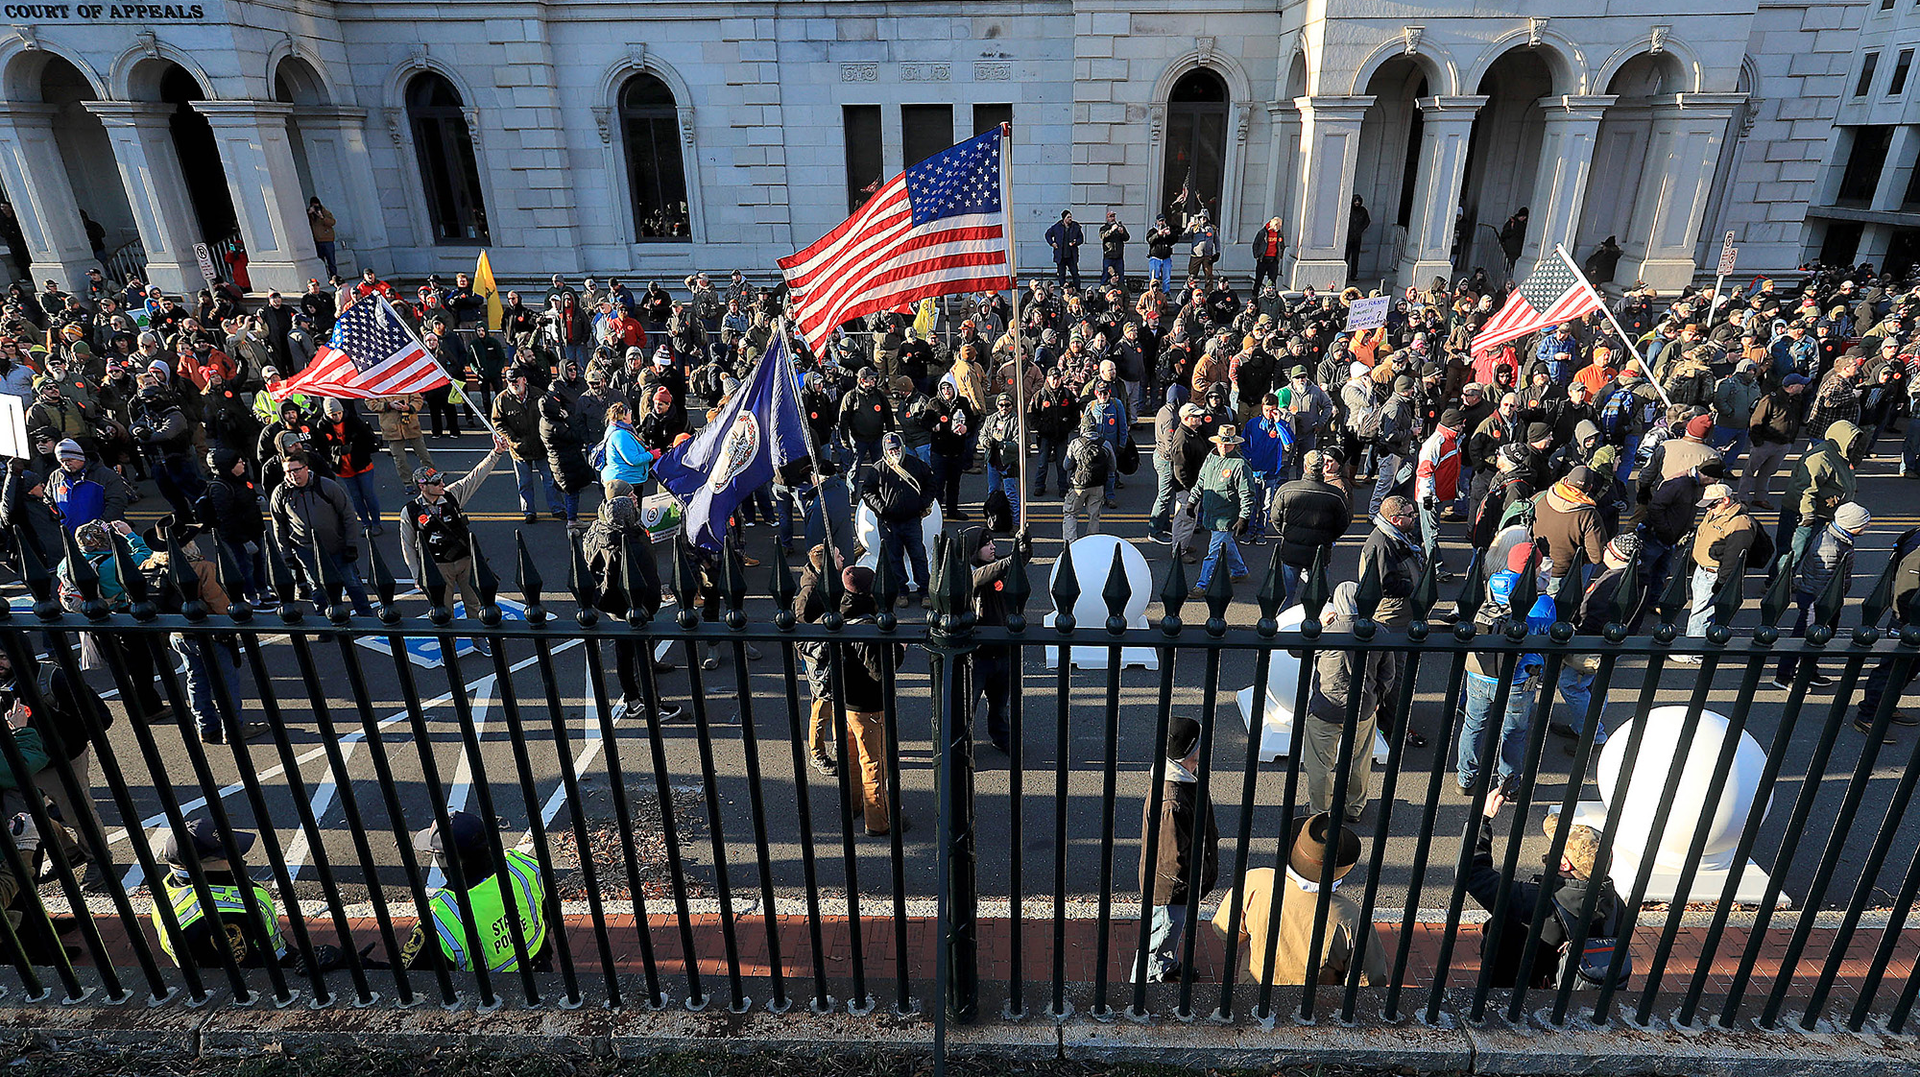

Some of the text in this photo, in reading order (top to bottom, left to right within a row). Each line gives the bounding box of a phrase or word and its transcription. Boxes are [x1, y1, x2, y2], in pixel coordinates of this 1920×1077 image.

[5, 4, 204, 18] COURT OF APPEALS
[492, 913, 512, 937] STA
